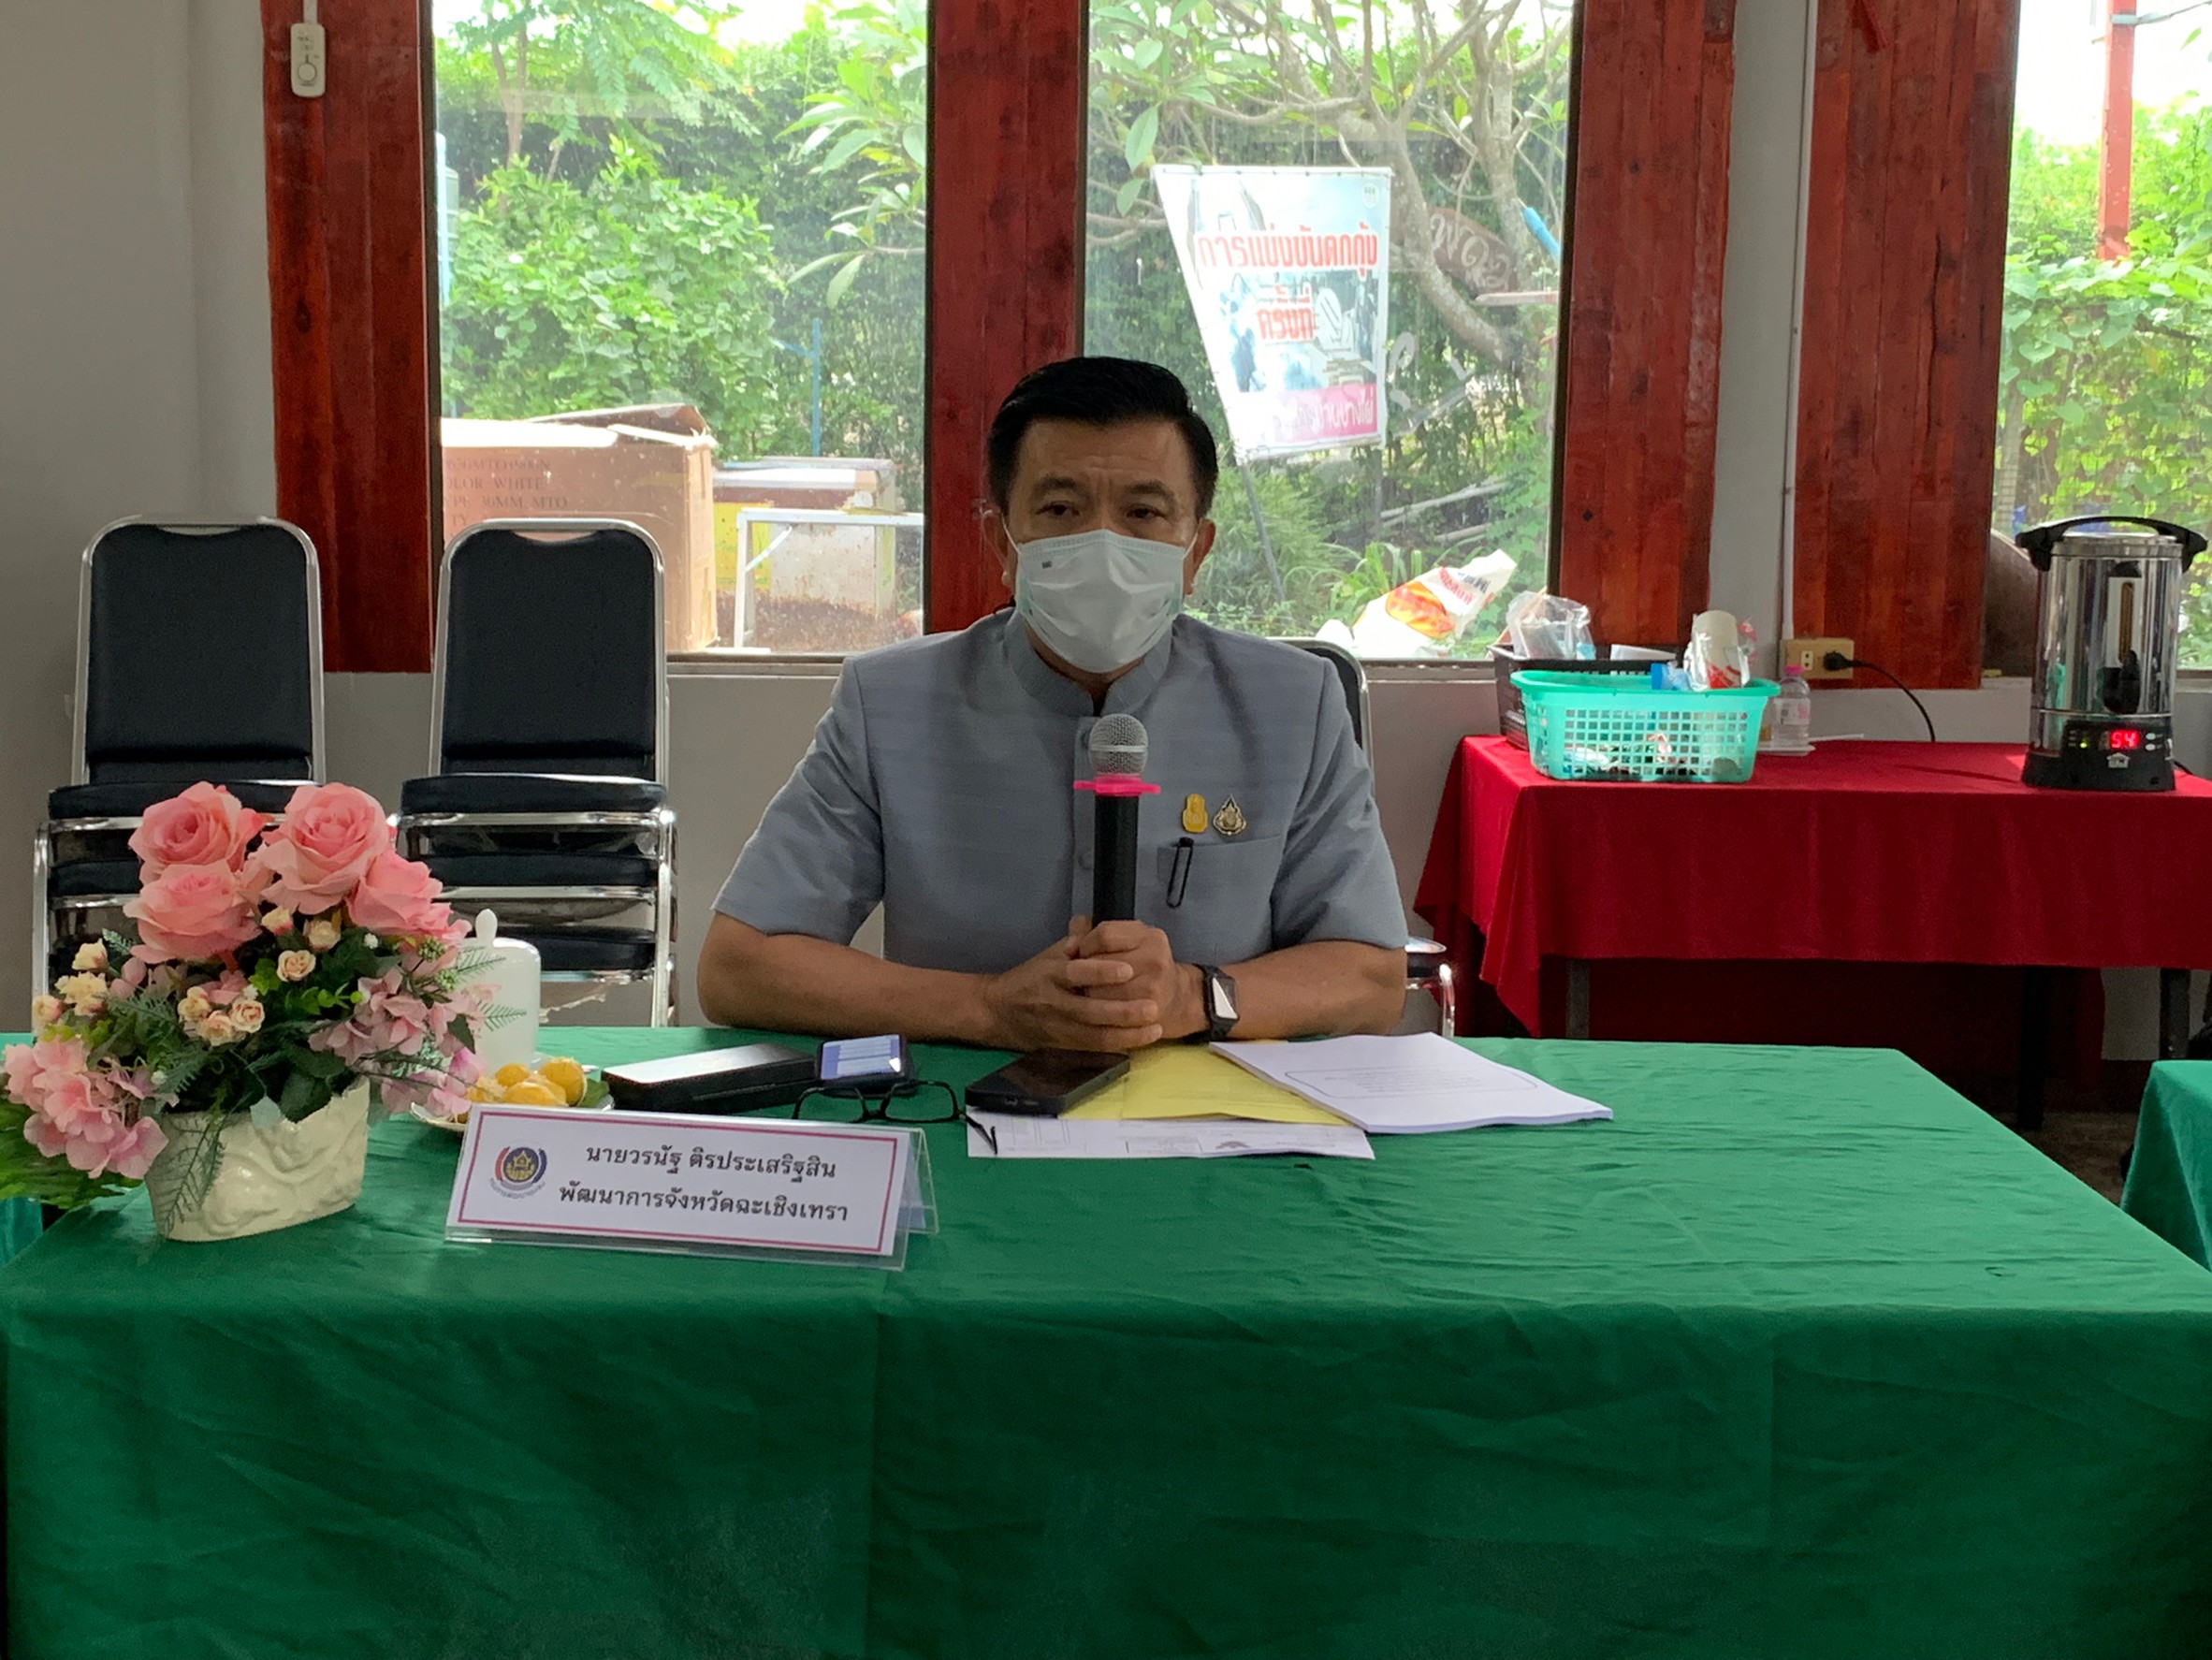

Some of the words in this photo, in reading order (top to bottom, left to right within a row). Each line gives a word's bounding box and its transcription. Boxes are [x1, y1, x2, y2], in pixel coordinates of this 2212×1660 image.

[493, 476, 546, 490] WHITE
[531, 495, 569, 509] MTO
[559, 1179, 850, 1223] พัฒนาการจังหวัดฉะเชิงเทรา
